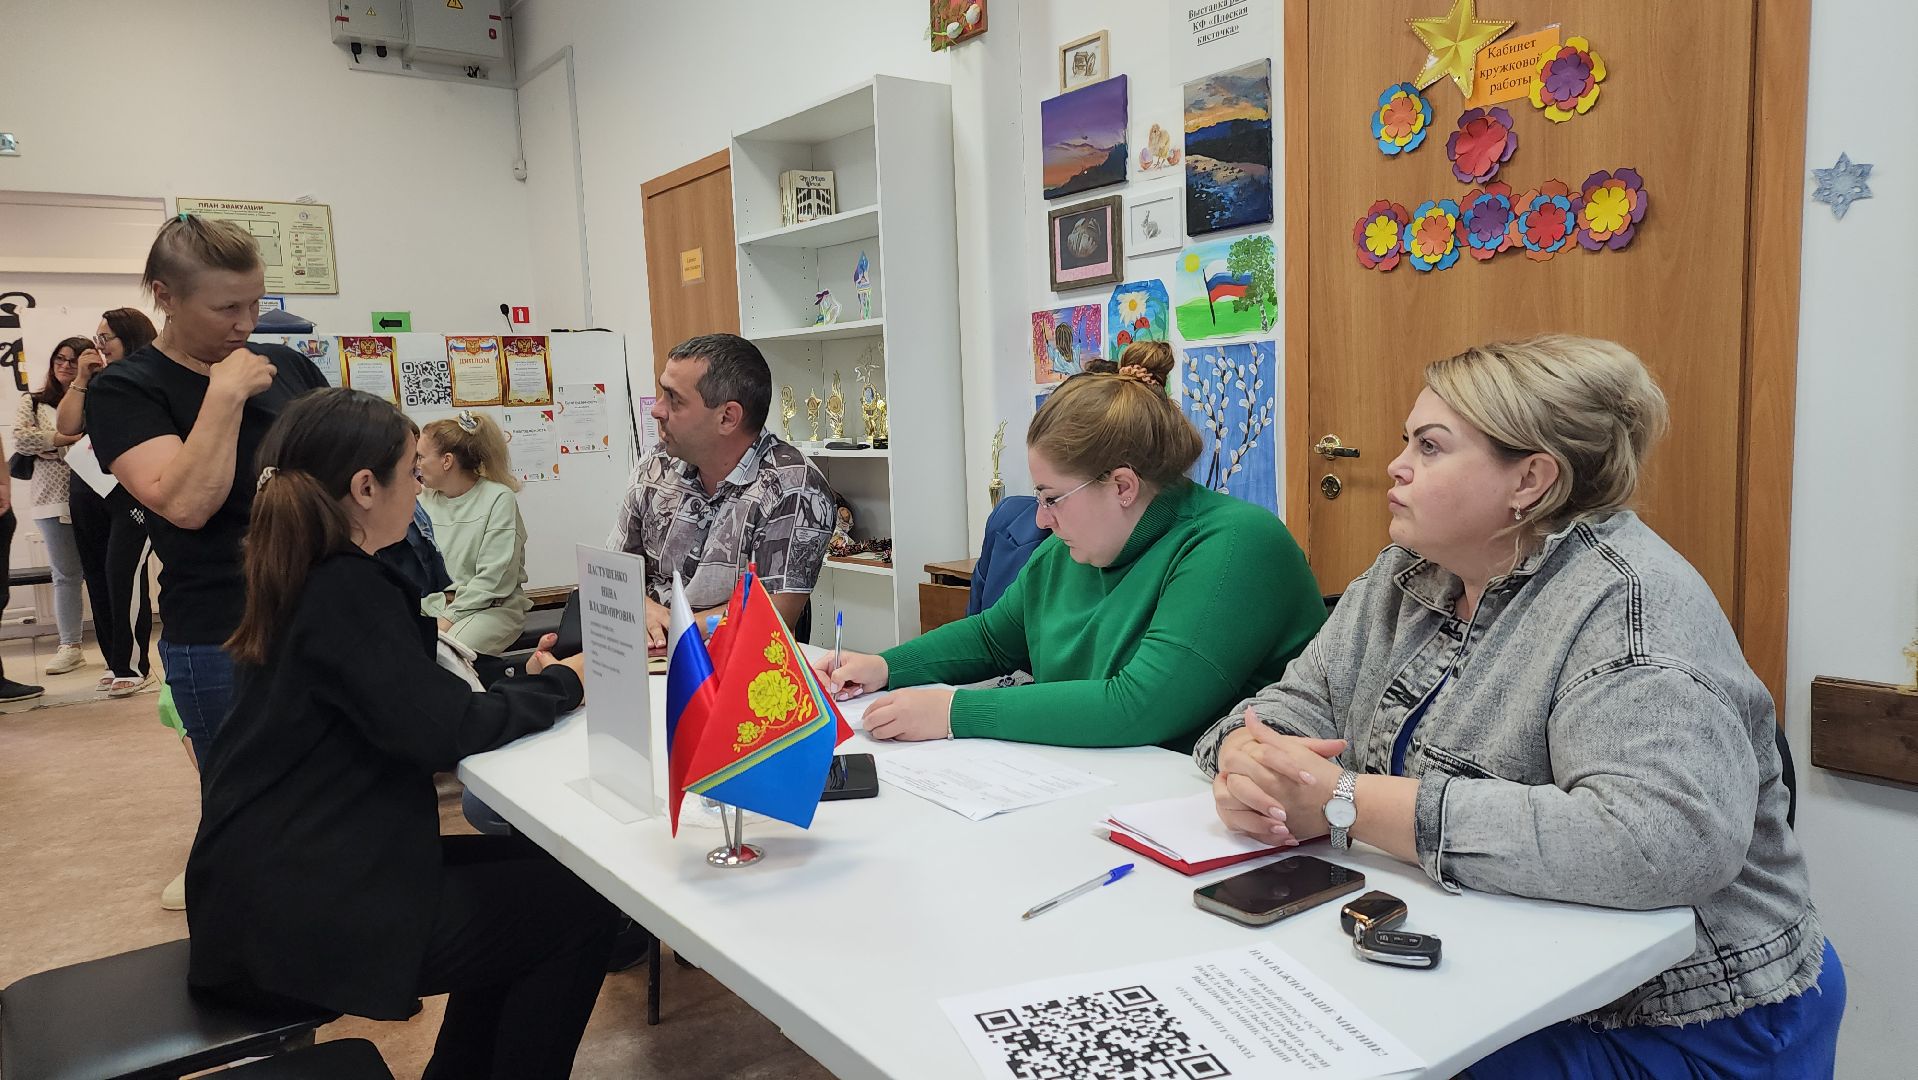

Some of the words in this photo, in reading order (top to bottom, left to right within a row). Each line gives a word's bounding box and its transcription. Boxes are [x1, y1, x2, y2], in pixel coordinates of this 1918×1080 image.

[1188, 0, 1228, 19] Выставка
[1193, 20, 1206, 31] КФ
[1197, 24, 1240, 44] кисточка»
[1487, 38, 1537, 59] Кабинет
[1489, 75, 1532, 95] работы
[220, 203, 264, 211] ЭВАКУАЦИИ
[459, 357, 490, 365] ДИПЛОМ
[587, 563, 628, 583] ПАСТУШЕНКО
[1249, 949, 1274, 965] НАМ
[1269, 965, 1306, 991] ВАЖНО
[1302, 991, 1337, 1014] ВАШЕ
[1335, 1015, 1389, 1057] МНЕНИЕ!
